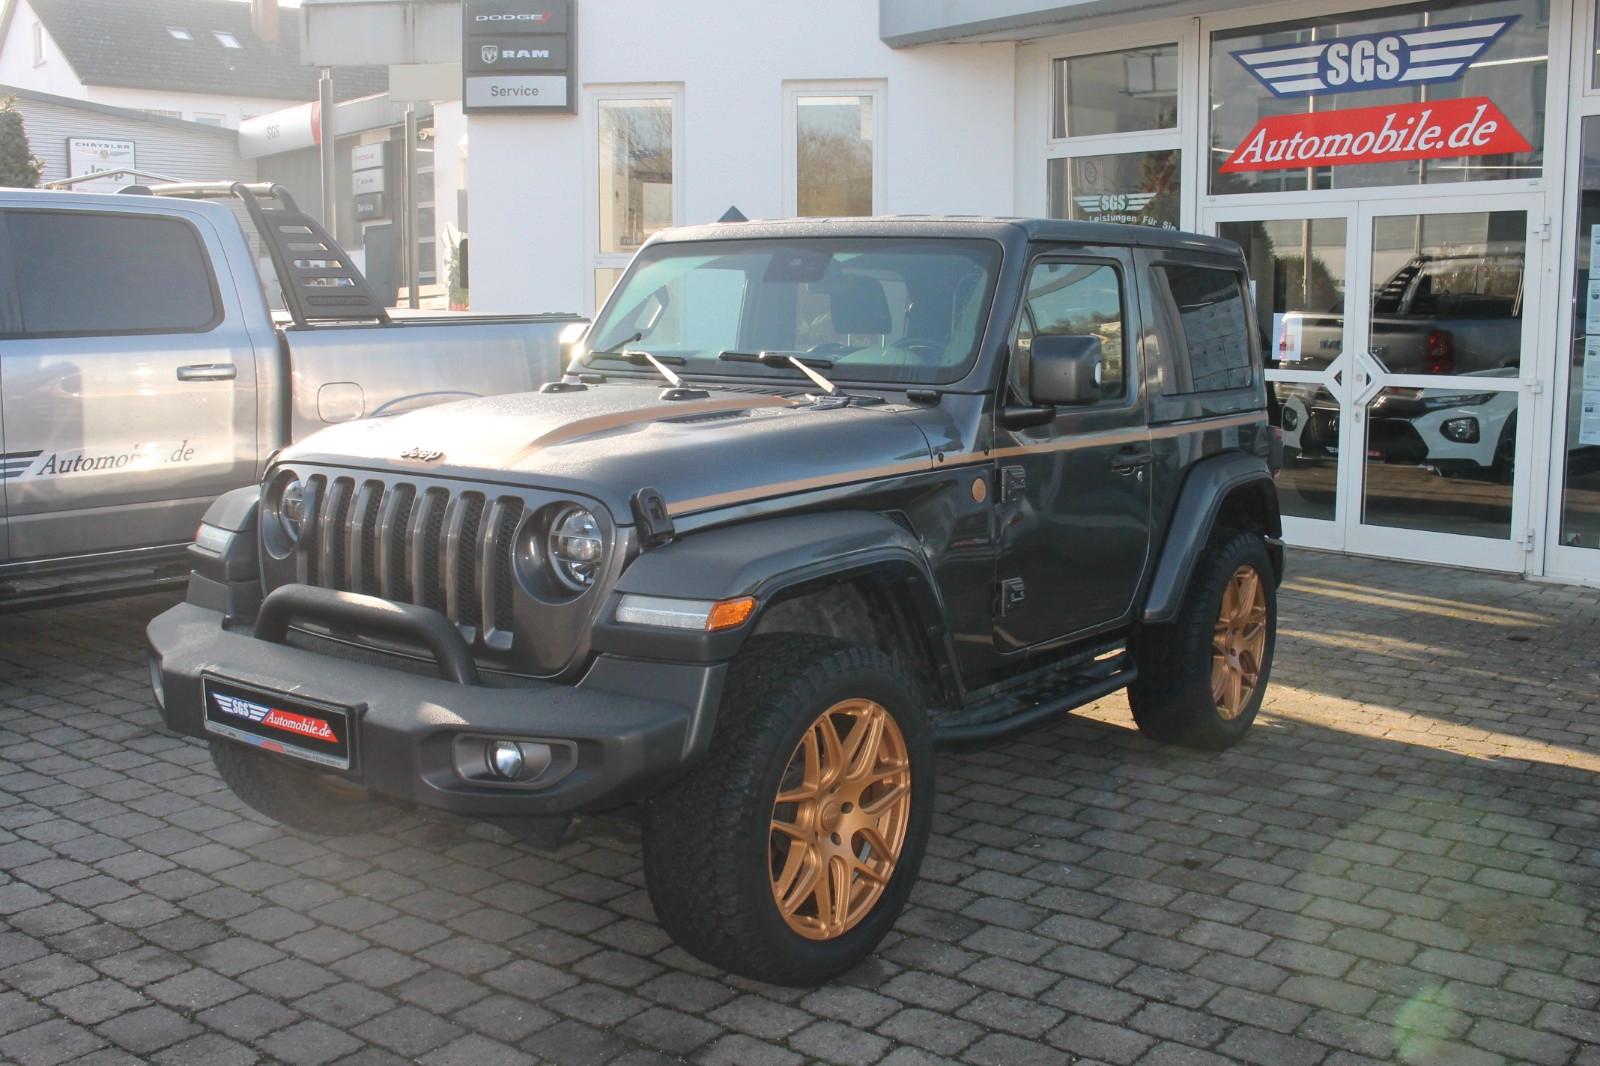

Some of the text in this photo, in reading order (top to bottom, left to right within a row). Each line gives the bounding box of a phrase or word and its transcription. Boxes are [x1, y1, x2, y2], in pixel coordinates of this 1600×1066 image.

[502, 50, 549, 58] RAM
[1326, 37, 1400, 86] SGS
[490, 85, 539, 97] Service
[1233, 103, 1498, 164] Automobile.de
[1101, 194, 1127, 211] SGS
[1142, 216, 1158, 226] Für
[37, 439, 195, 476] Automo.de
[232, 700, 331, 737] SGS Automobile.de
